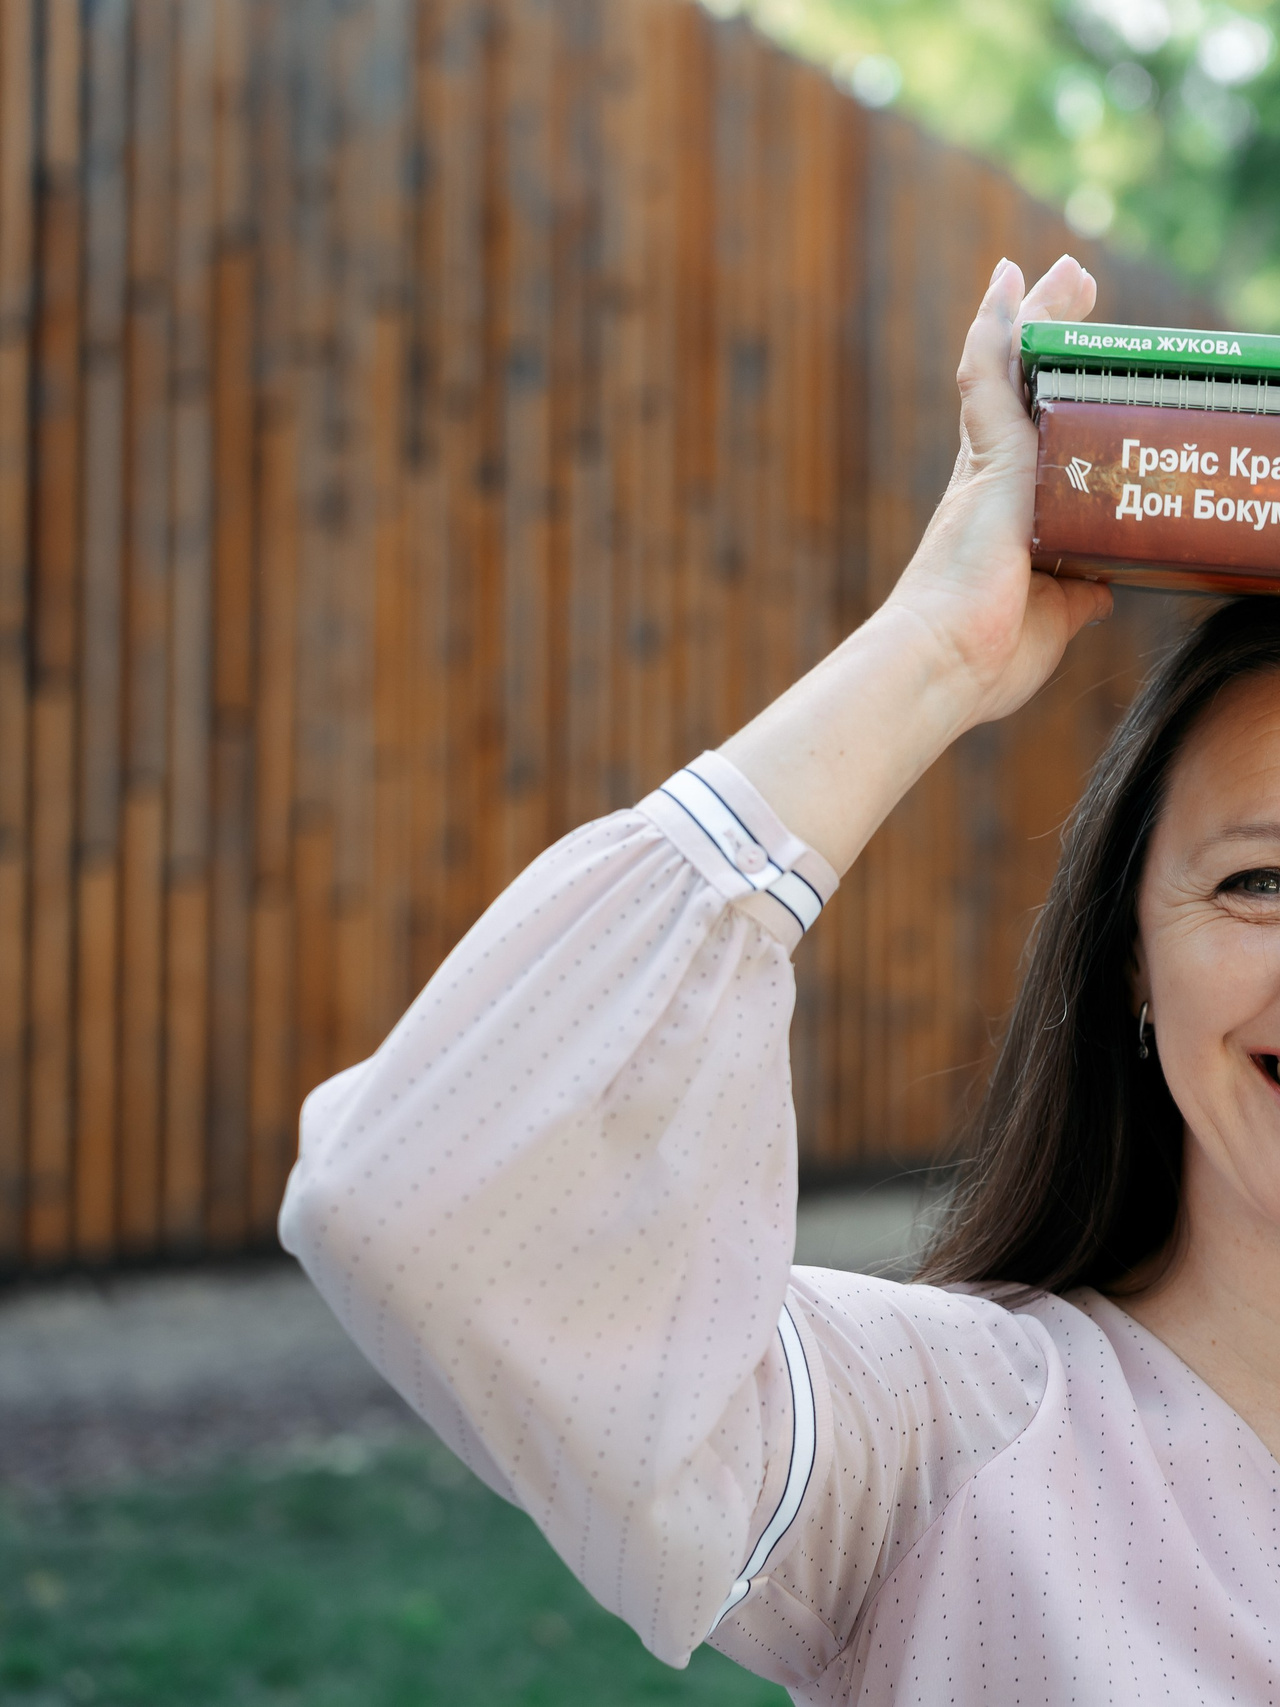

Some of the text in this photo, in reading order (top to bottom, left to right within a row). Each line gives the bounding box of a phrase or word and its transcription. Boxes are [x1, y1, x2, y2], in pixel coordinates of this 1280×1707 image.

[1064, 330, 1242, 356] Надежда ЖУКОВА
[1121, 438, 1219, 479] Грэйс
[1115, 484, 1182, 521] Дон
